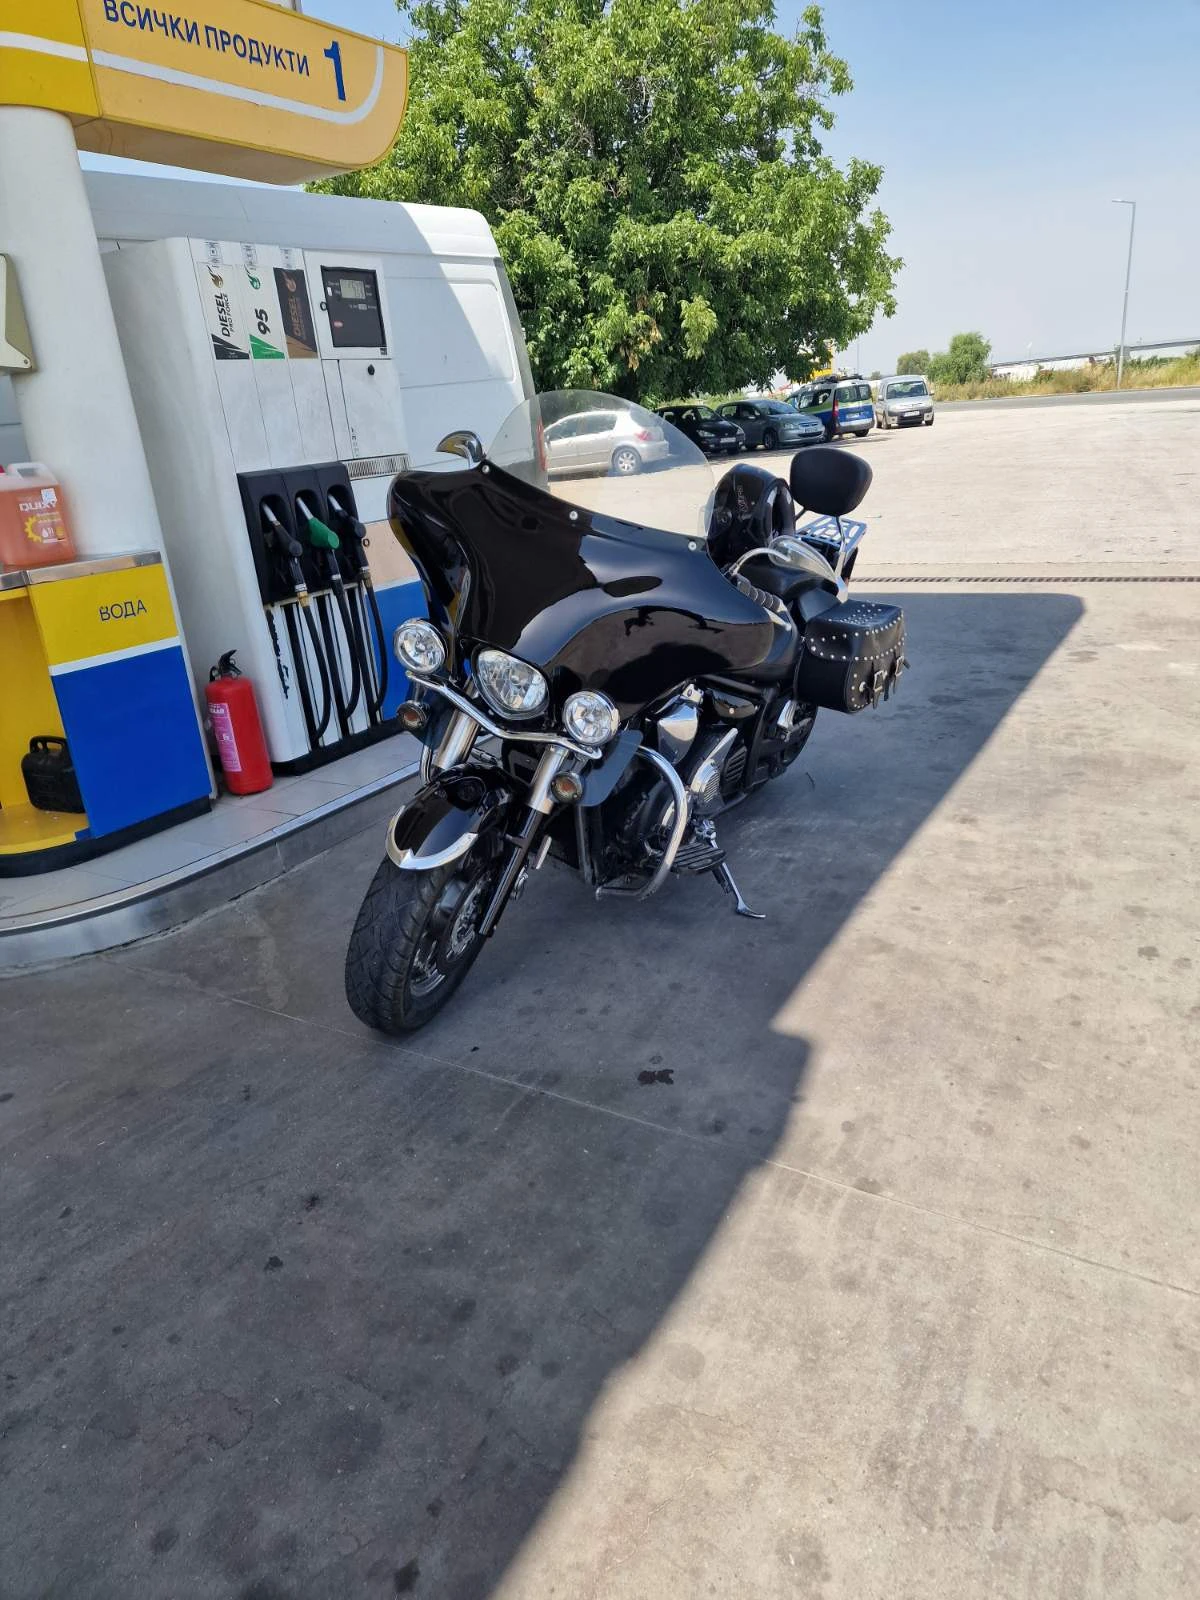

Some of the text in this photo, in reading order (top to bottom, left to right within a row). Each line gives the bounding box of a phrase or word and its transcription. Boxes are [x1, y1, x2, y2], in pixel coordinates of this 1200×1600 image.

[103, 0, 310, 77] ВСИЧКИ ПРОДУКТИ
[323, 40, 347, 102] 1
[214, 292, 231, 337] DIESEL
[254, 307, 271, 335] 95
[99, 599, 148, 622] ВОДА
